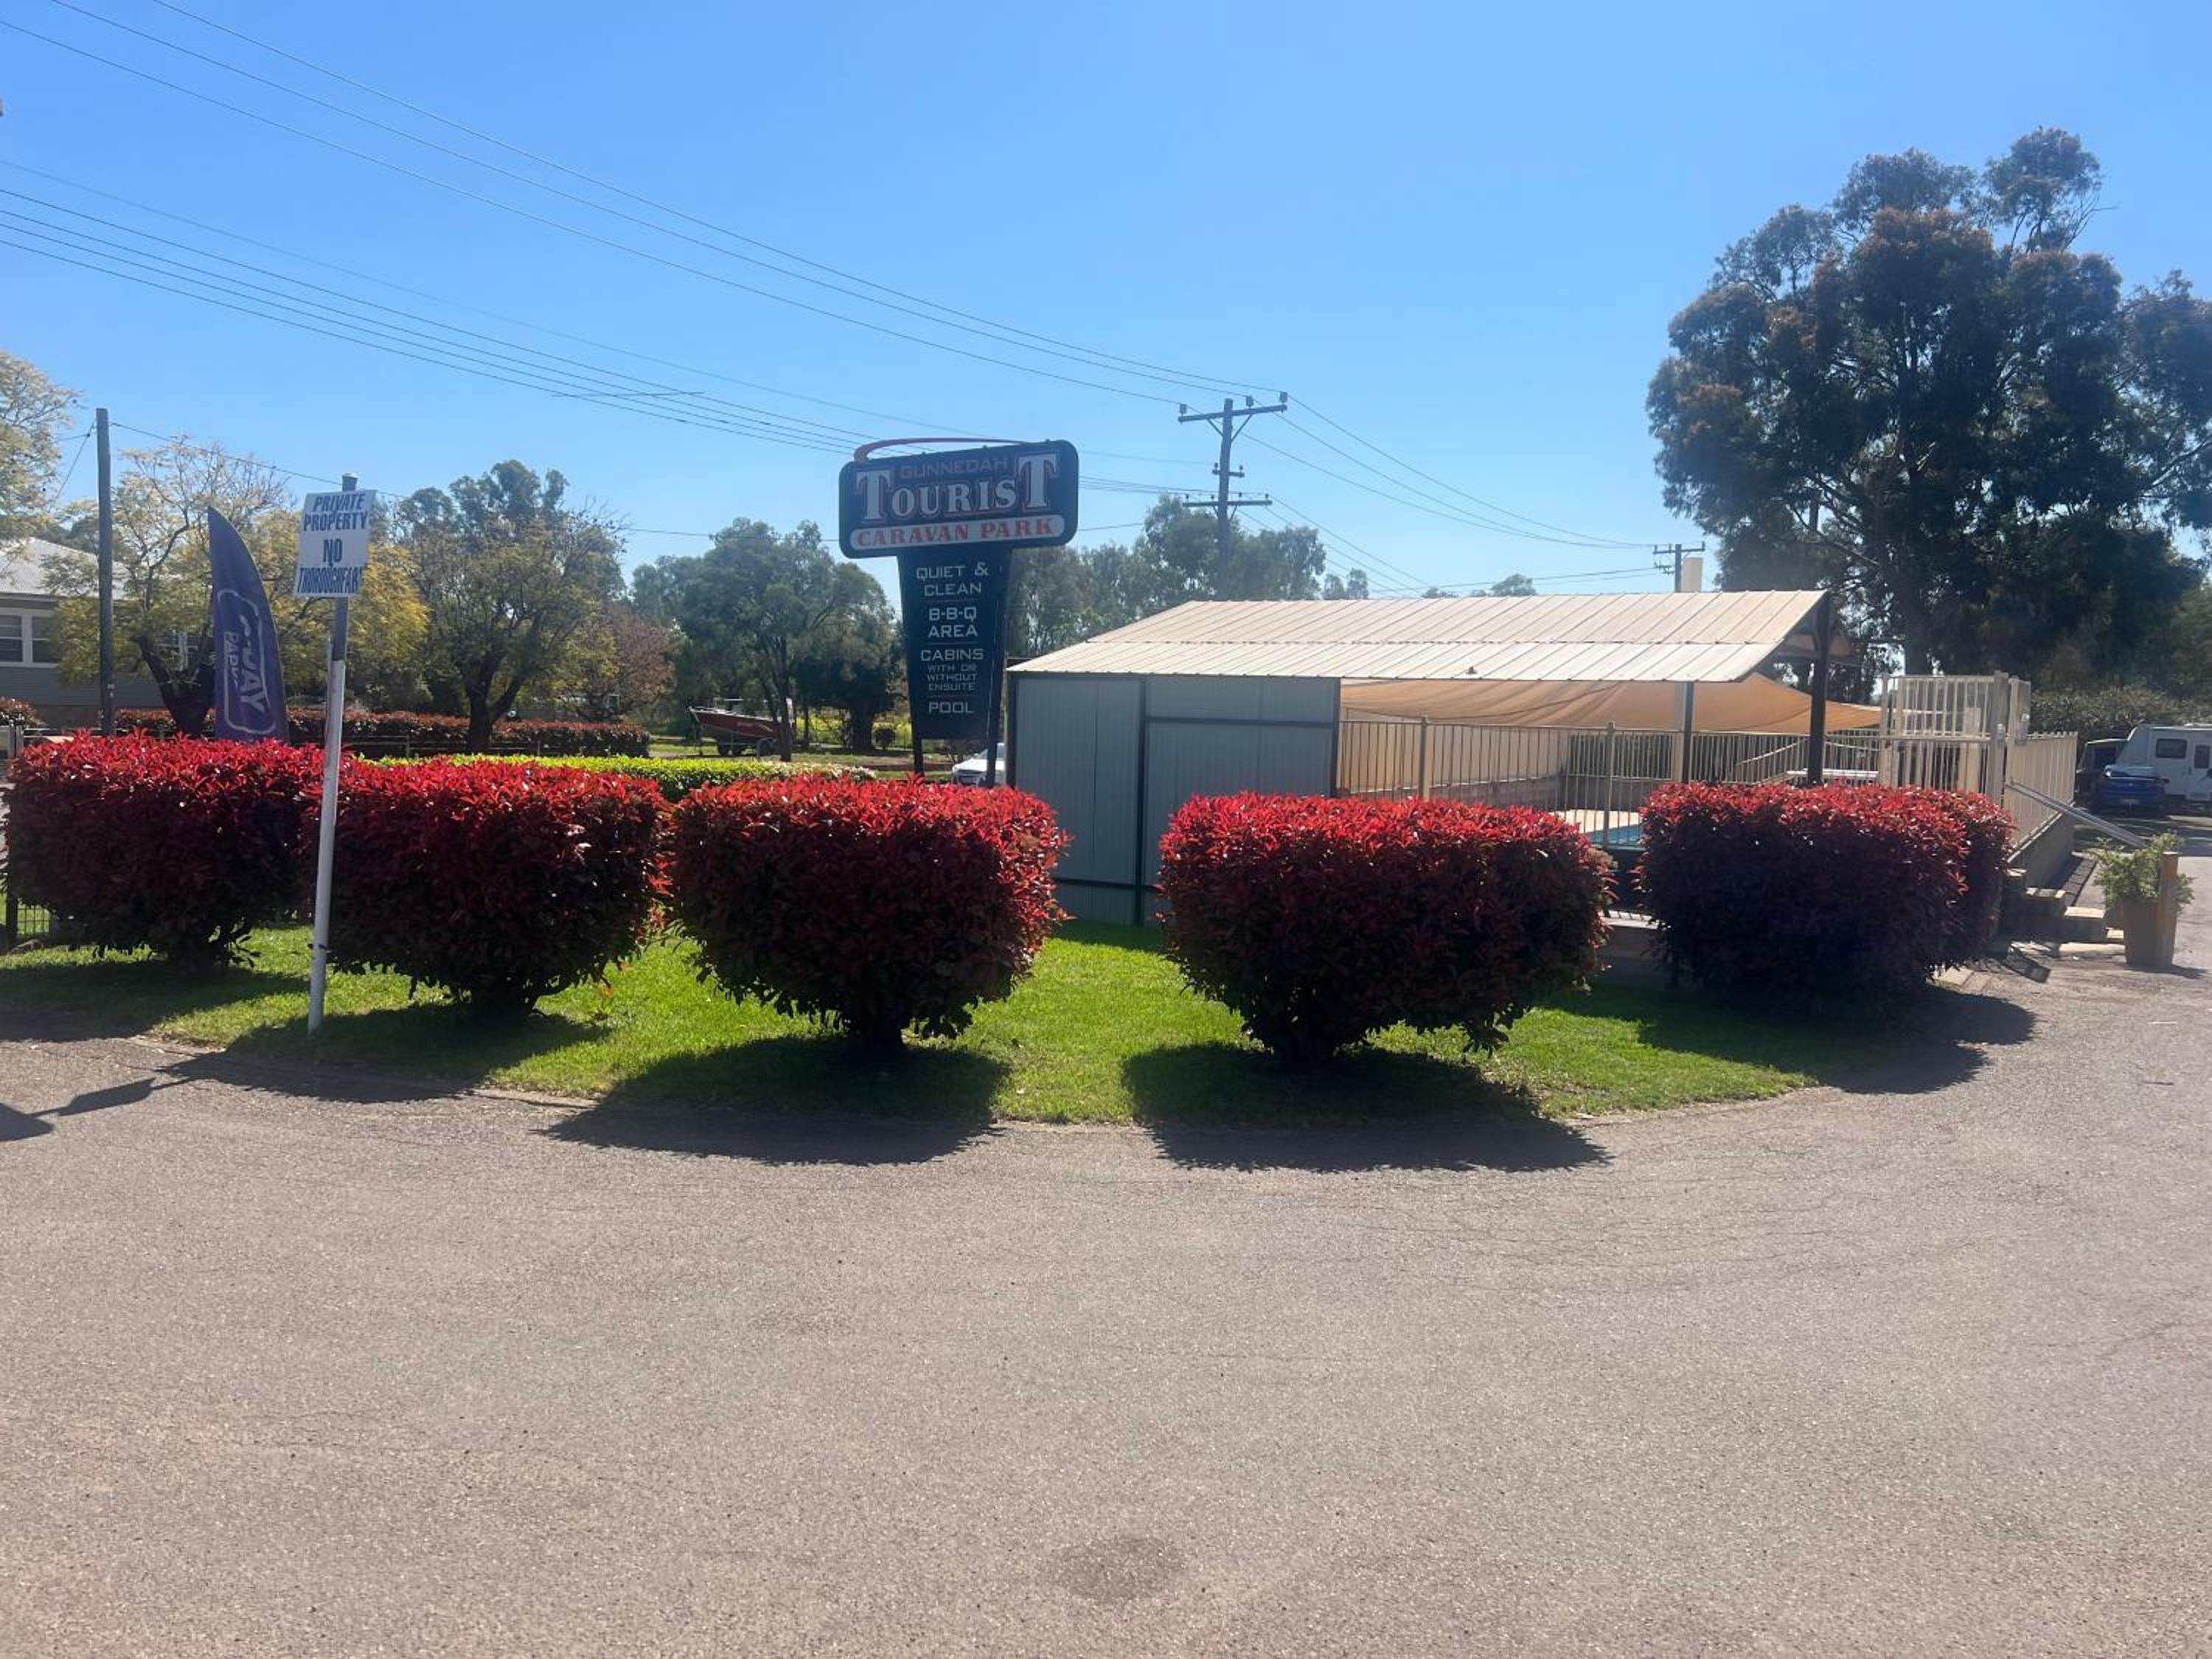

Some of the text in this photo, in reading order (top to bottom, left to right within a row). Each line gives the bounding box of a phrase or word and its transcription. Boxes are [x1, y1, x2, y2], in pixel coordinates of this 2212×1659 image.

[900, 457, 1009, 479] GUNNEDAH
[855, 452, 1058, 521] TOURIST
[313, 493, 366, 512] PRIVATE
[303, 510, 368, 532] PROPERTY
[858, 518, 1053, 546] CARAVAN PARK
[322, 538, 343, 563] NO
[917, 561, 989, 582] QUIET &
[924, 582, 982, 597] CLEAN
[928, 606, 977, 622] B-B-Q
[928, 625, 978, 638] AREA
[920, 648, 984, 661] CABINS
[927, 664, 978, 672] WITH OR
[926, 673, 978, 682] WITHOUT
[928, 682, 975, 691] ENSUITE
[928, 701, 974, 714] POOL
